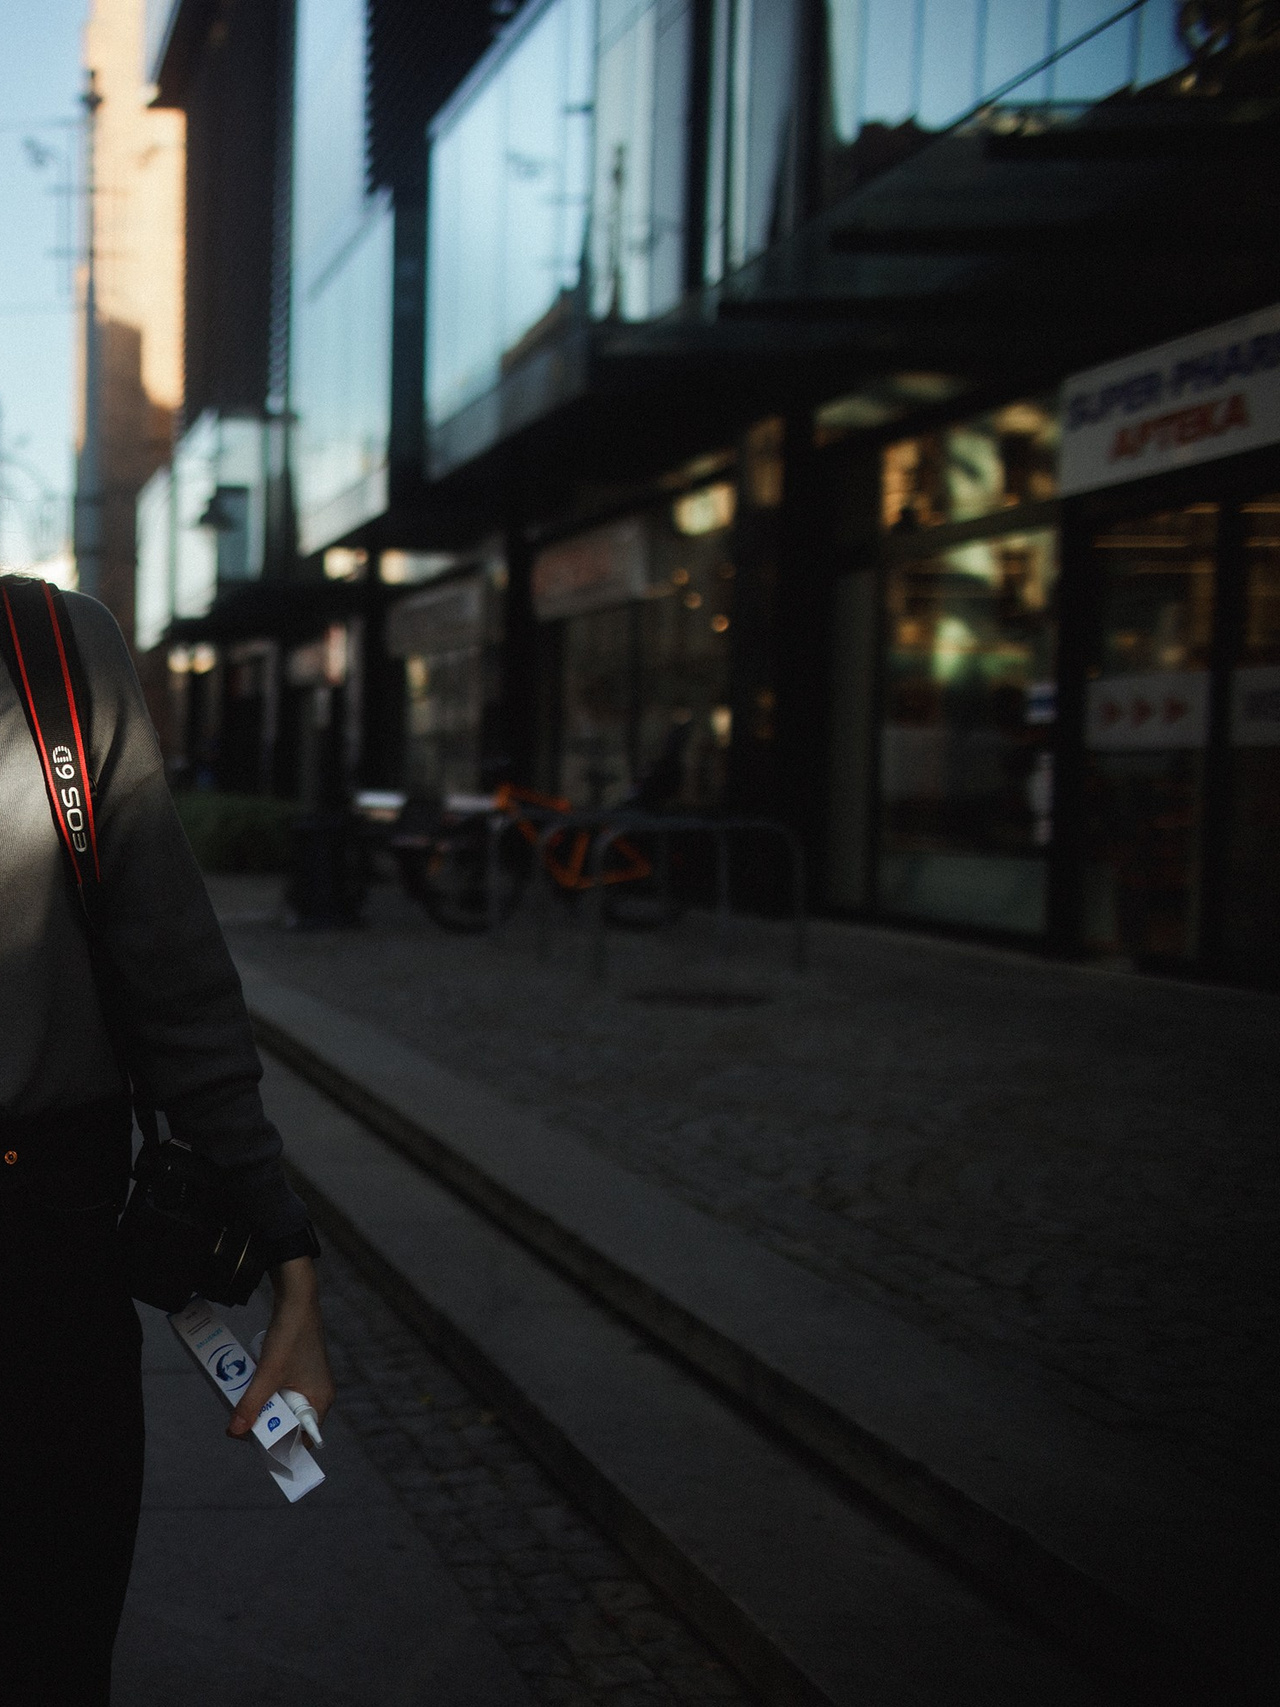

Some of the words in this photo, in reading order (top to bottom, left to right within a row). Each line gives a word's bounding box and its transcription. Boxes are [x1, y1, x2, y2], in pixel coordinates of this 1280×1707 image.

[1108, 393, 1249, 464] APTEKA
[52, 745, 75, 779] 6D
[61, 786, 87, 852] EOS
